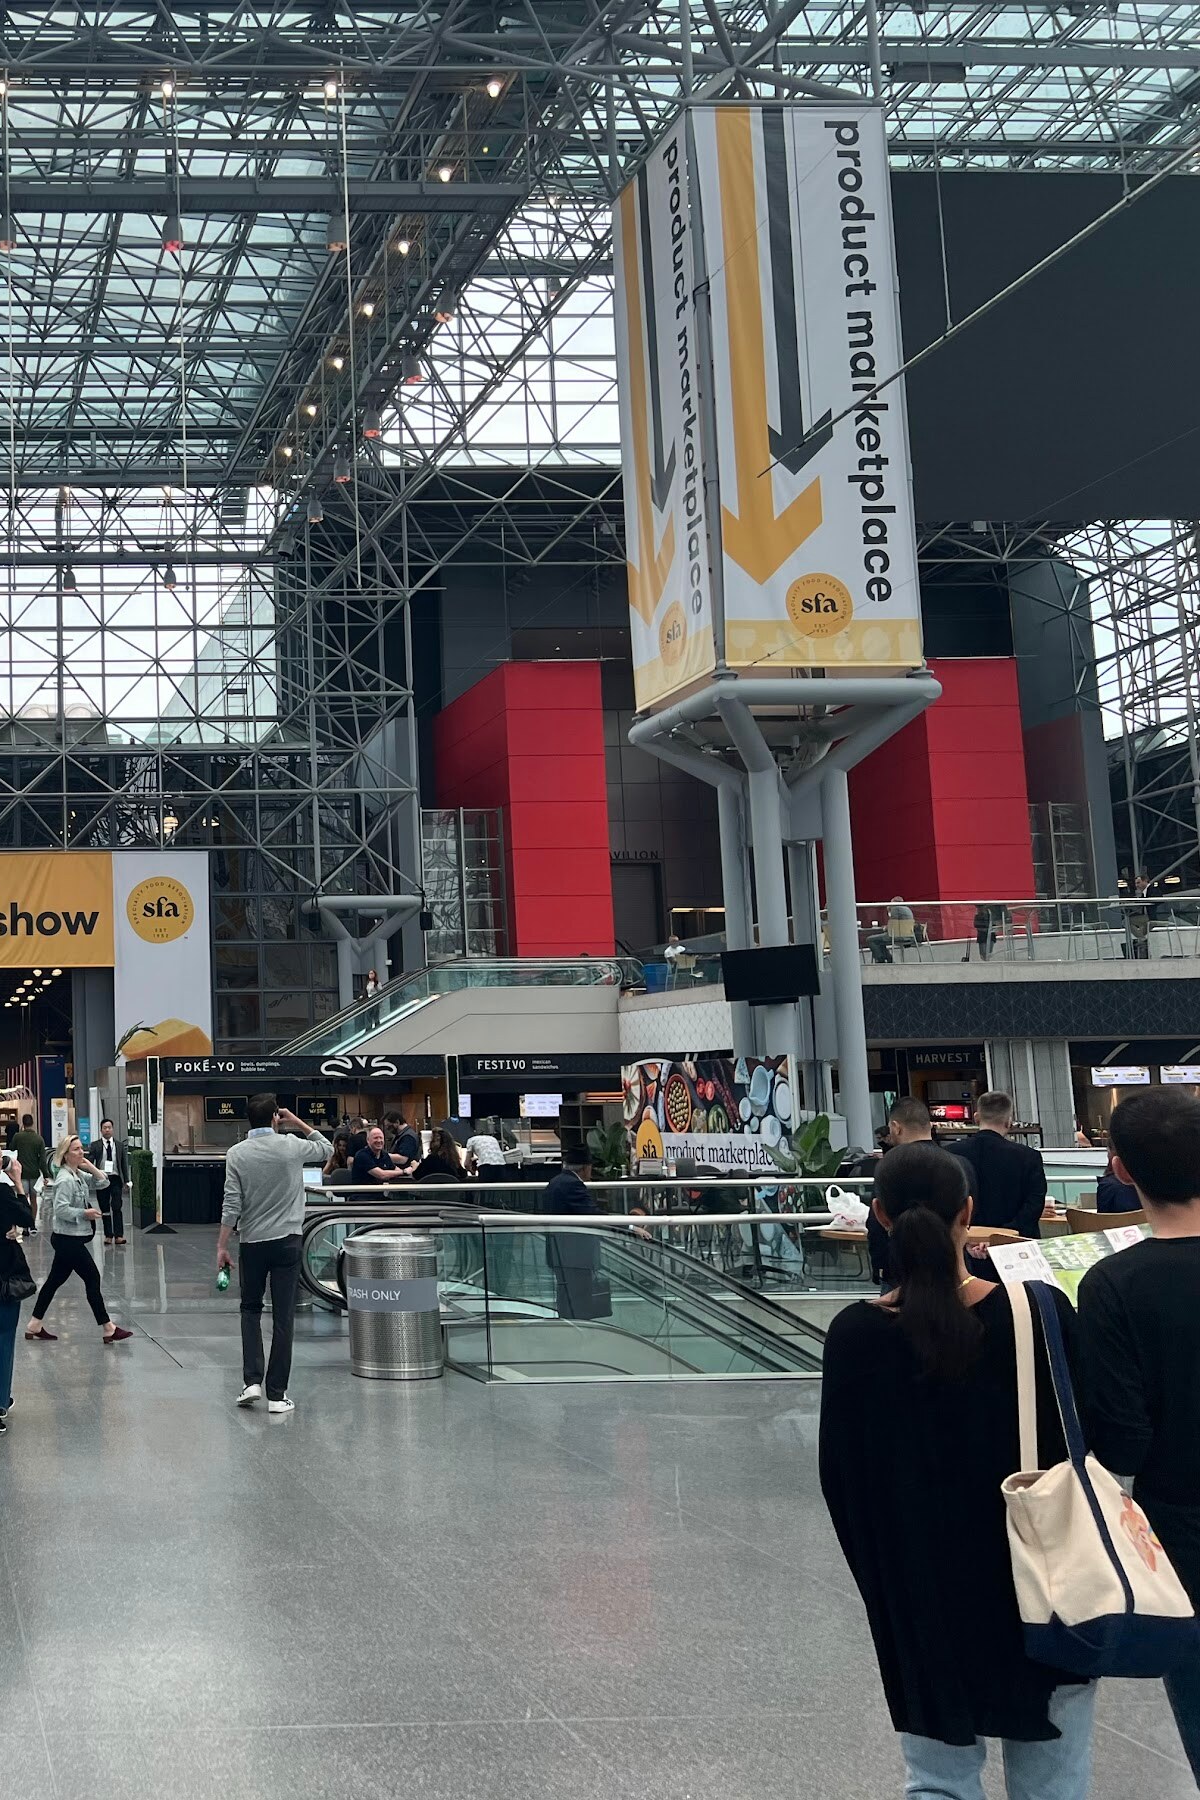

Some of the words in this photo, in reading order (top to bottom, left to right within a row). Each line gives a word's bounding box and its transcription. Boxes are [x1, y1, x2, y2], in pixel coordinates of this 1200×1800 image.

[824, 120, 877, 297] product
[662, 137, 689, 318] product
[676, 325, 703, 616] marketplace
[847, 310, 896, 603] marketplace
[801, 592, 839, 614] sfa
[609, 850, 658, 860] VILION
[142, 896, 180, 917] sfa
[175, 1059, 235, 1072] POKÉ-YO
[477, 1060, 526, 1070] FESTIVO
[915, 1052, 970, 1064] HARVEST
[642, 1139, 657, 1158] sfa
[708, 1141, 774, 1171] marketplac
[347, 1287, 368, 1299] RASH
[371, 1290, 400, 1300] ONLY
